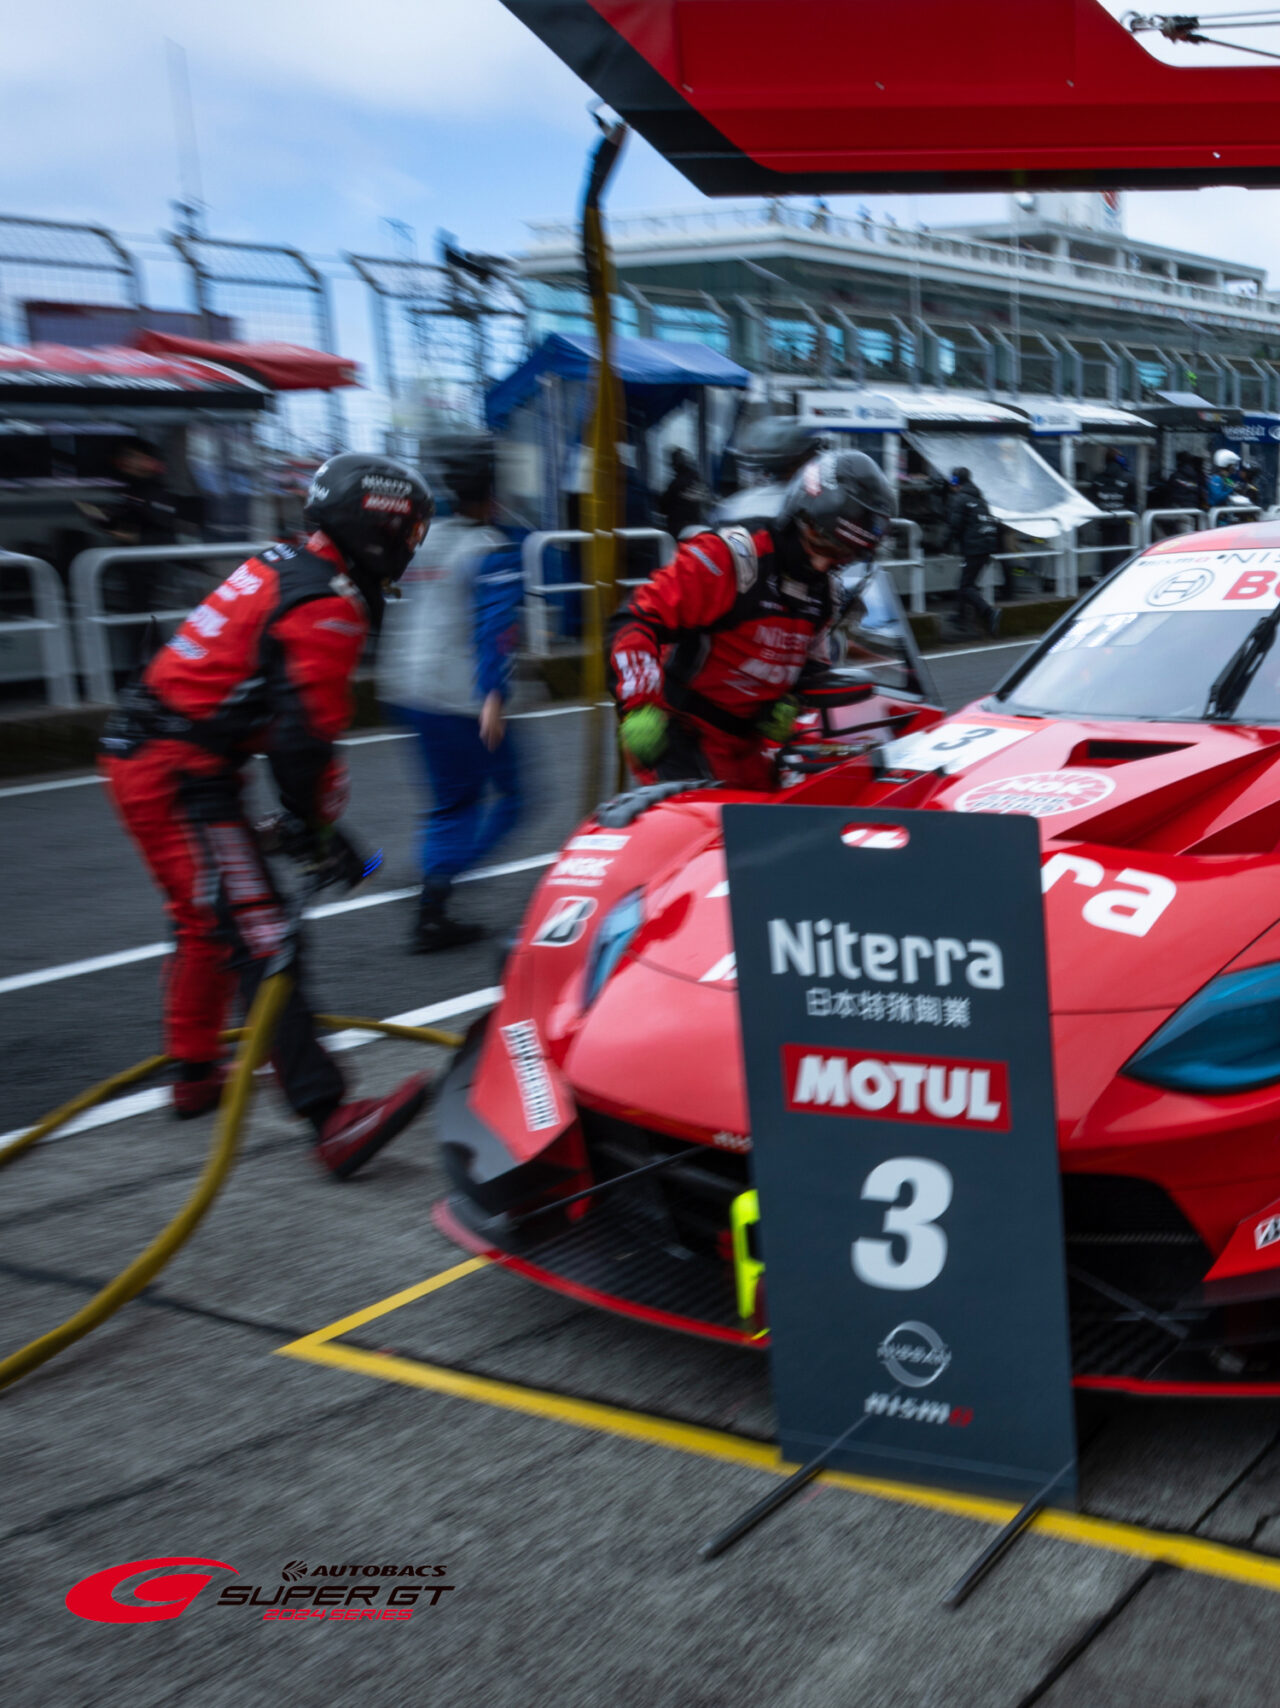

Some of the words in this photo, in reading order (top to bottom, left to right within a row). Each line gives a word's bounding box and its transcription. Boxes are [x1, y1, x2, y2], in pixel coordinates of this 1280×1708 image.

[930, 727, 997, 751] 3
[767, 918, 1005, 990] Niterra
[792, 1054, 1002, 1122] MOTUL
[851, 1155, 955, 1291] 3
